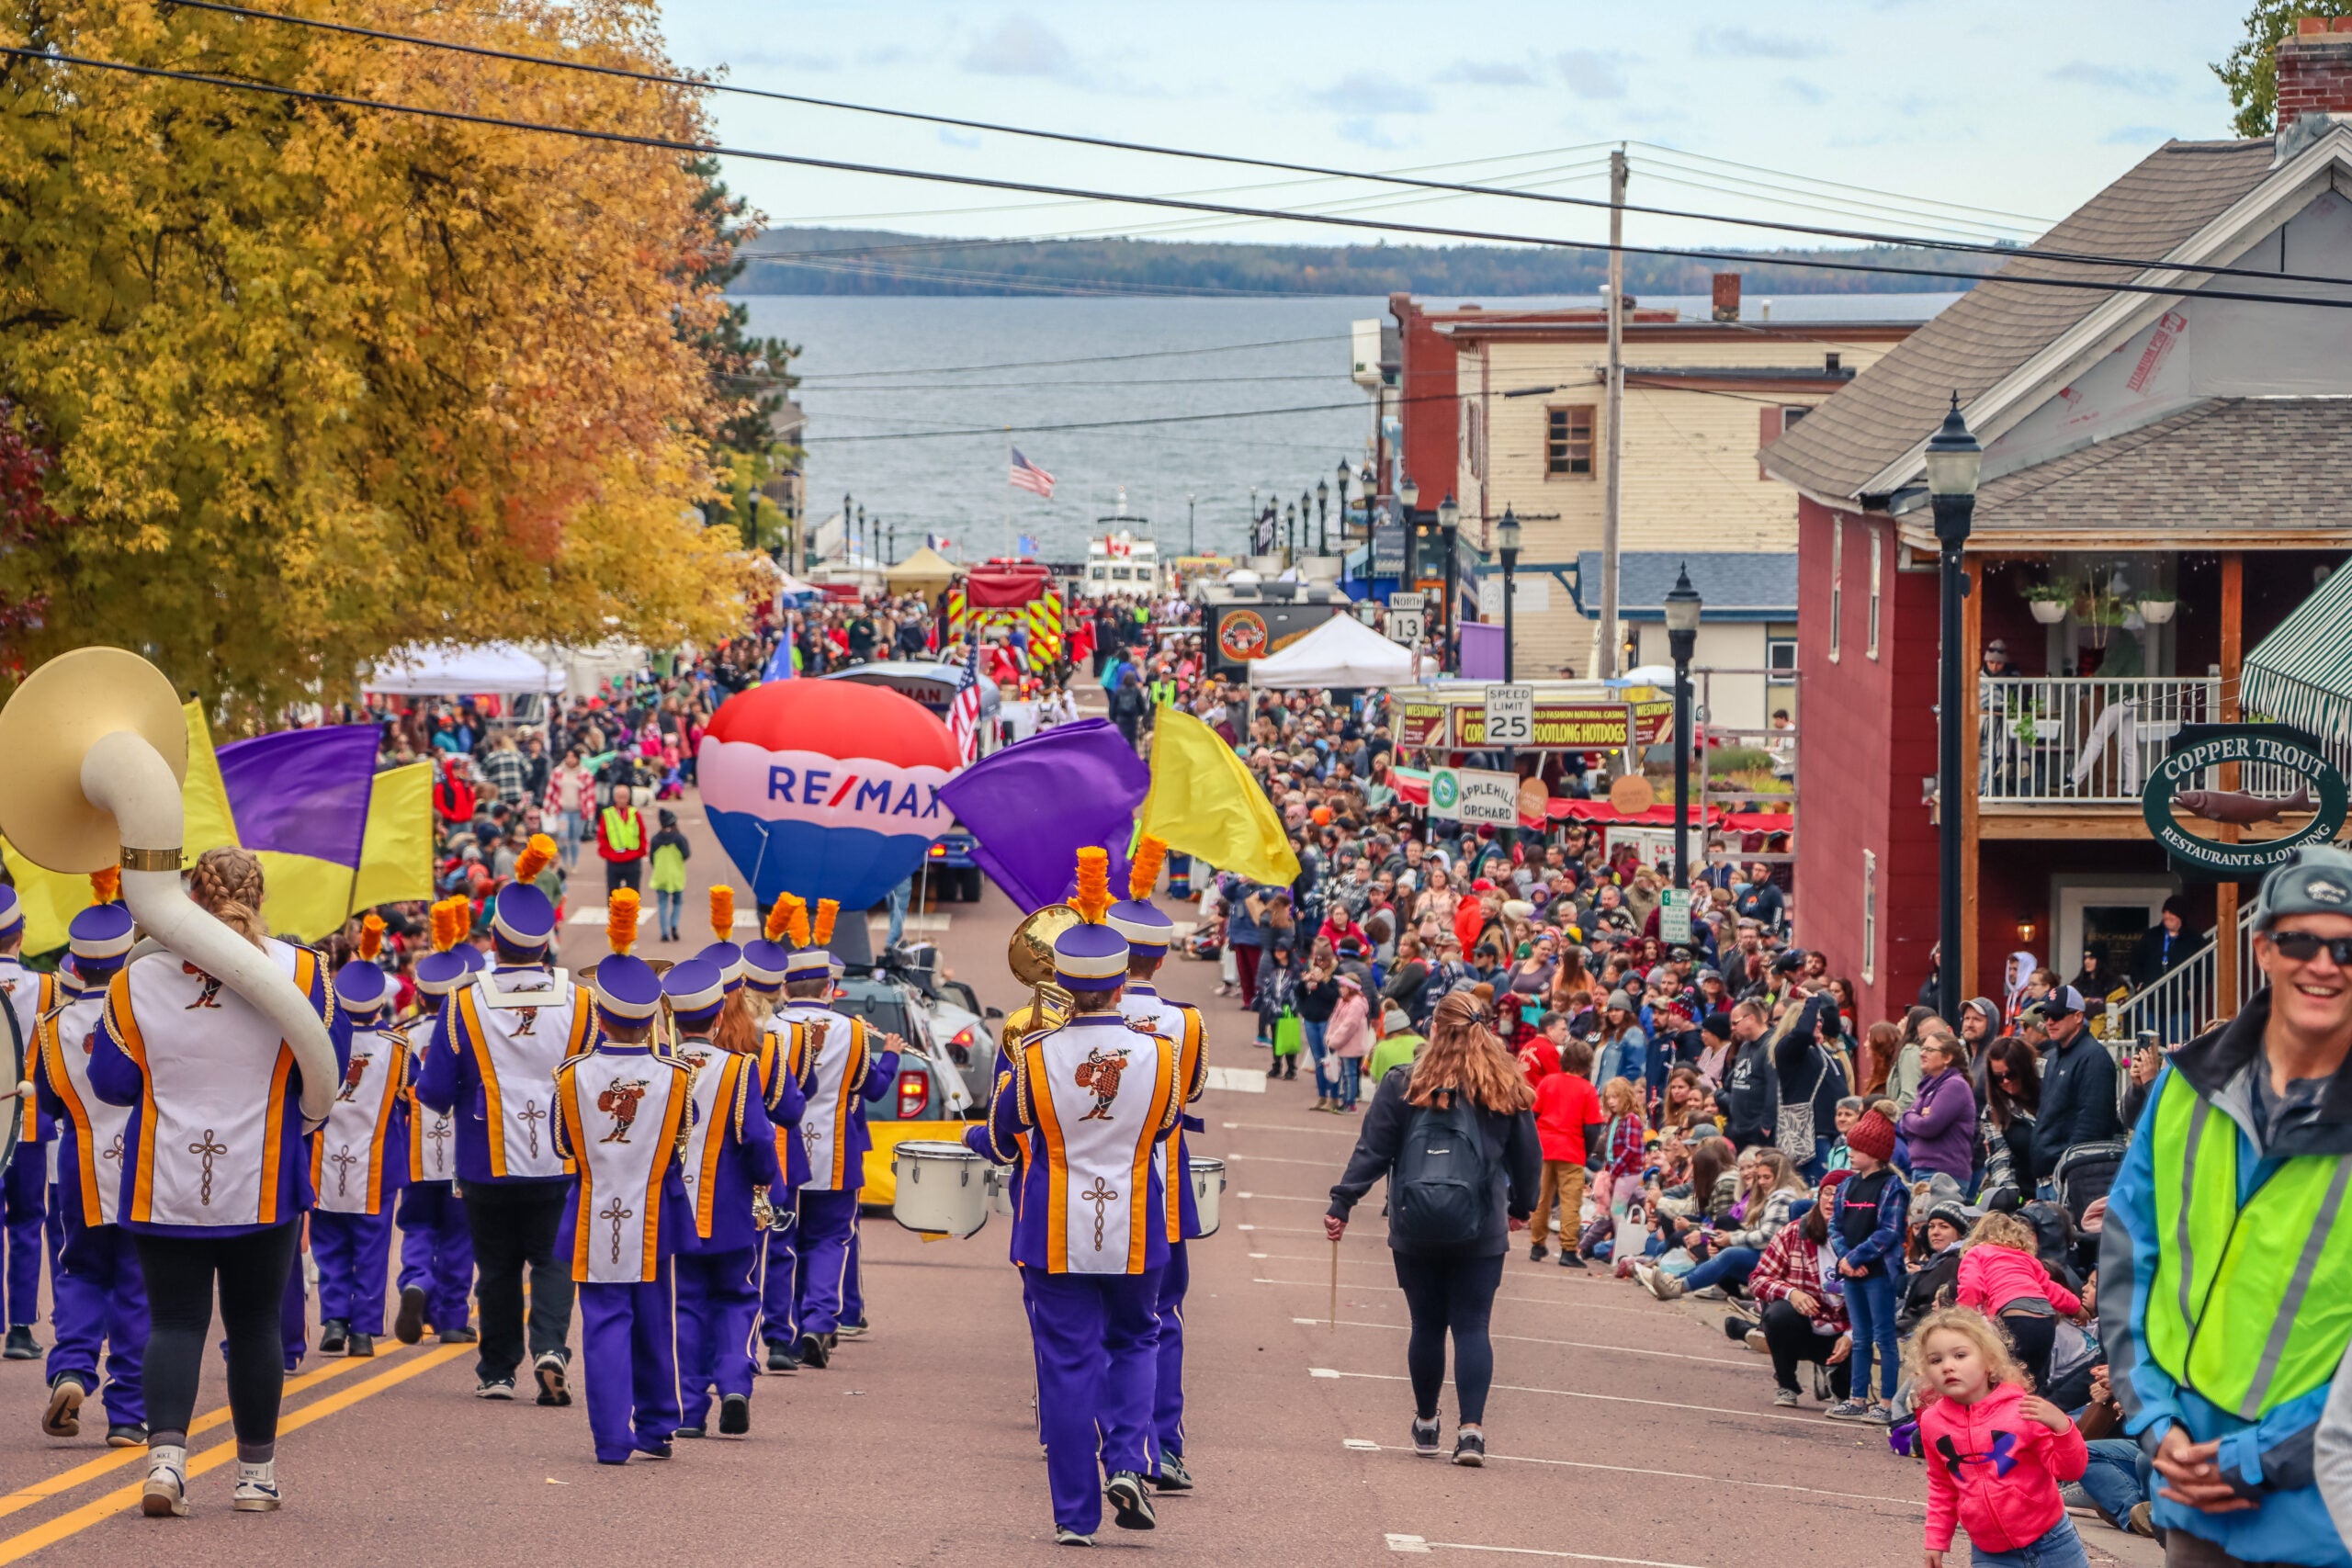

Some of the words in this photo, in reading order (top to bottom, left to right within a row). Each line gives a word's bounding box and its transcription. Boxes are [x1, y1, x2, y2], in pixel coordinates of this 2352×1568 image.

[1393, 596, 1423, 606] NORTH
[1397, 619, 1418, 637] 13
[1489, 690, 1530, 699] SPEED
[1406, 704, 1445, 718] WESTRUM'S
[1494, 702, 1523, 711] LIMIT
[1533, 710, 1546, 719] OLD
[1546, 710, 1574, 719] FASHION
[1574, 710, 1602, 719] NATURAL
[1603, 710, 1626, 719] CASING
[1636, 703, 1673, 716] WESTRUM'S
[1464, 723, 1486, 743] COR
[1533, 723, 1580, 743] FOOTLONG
[1581, 723, 1626, 743] HOTDOGS
[1490, 716, 1527, 737] 25
[2164, 738, 2250, 780] COPPER
[2255, 738, 2327, 781] TROUT
[768, 764, 941, 818] RE/MAX
[1462, 783, 1515, 807] APPLEHILL
[1464, 804, 1511, 819] ORCHARD
[2160, 825, 2251, 866] RESTAURANT
[2252, 854, 2265, 865] &
